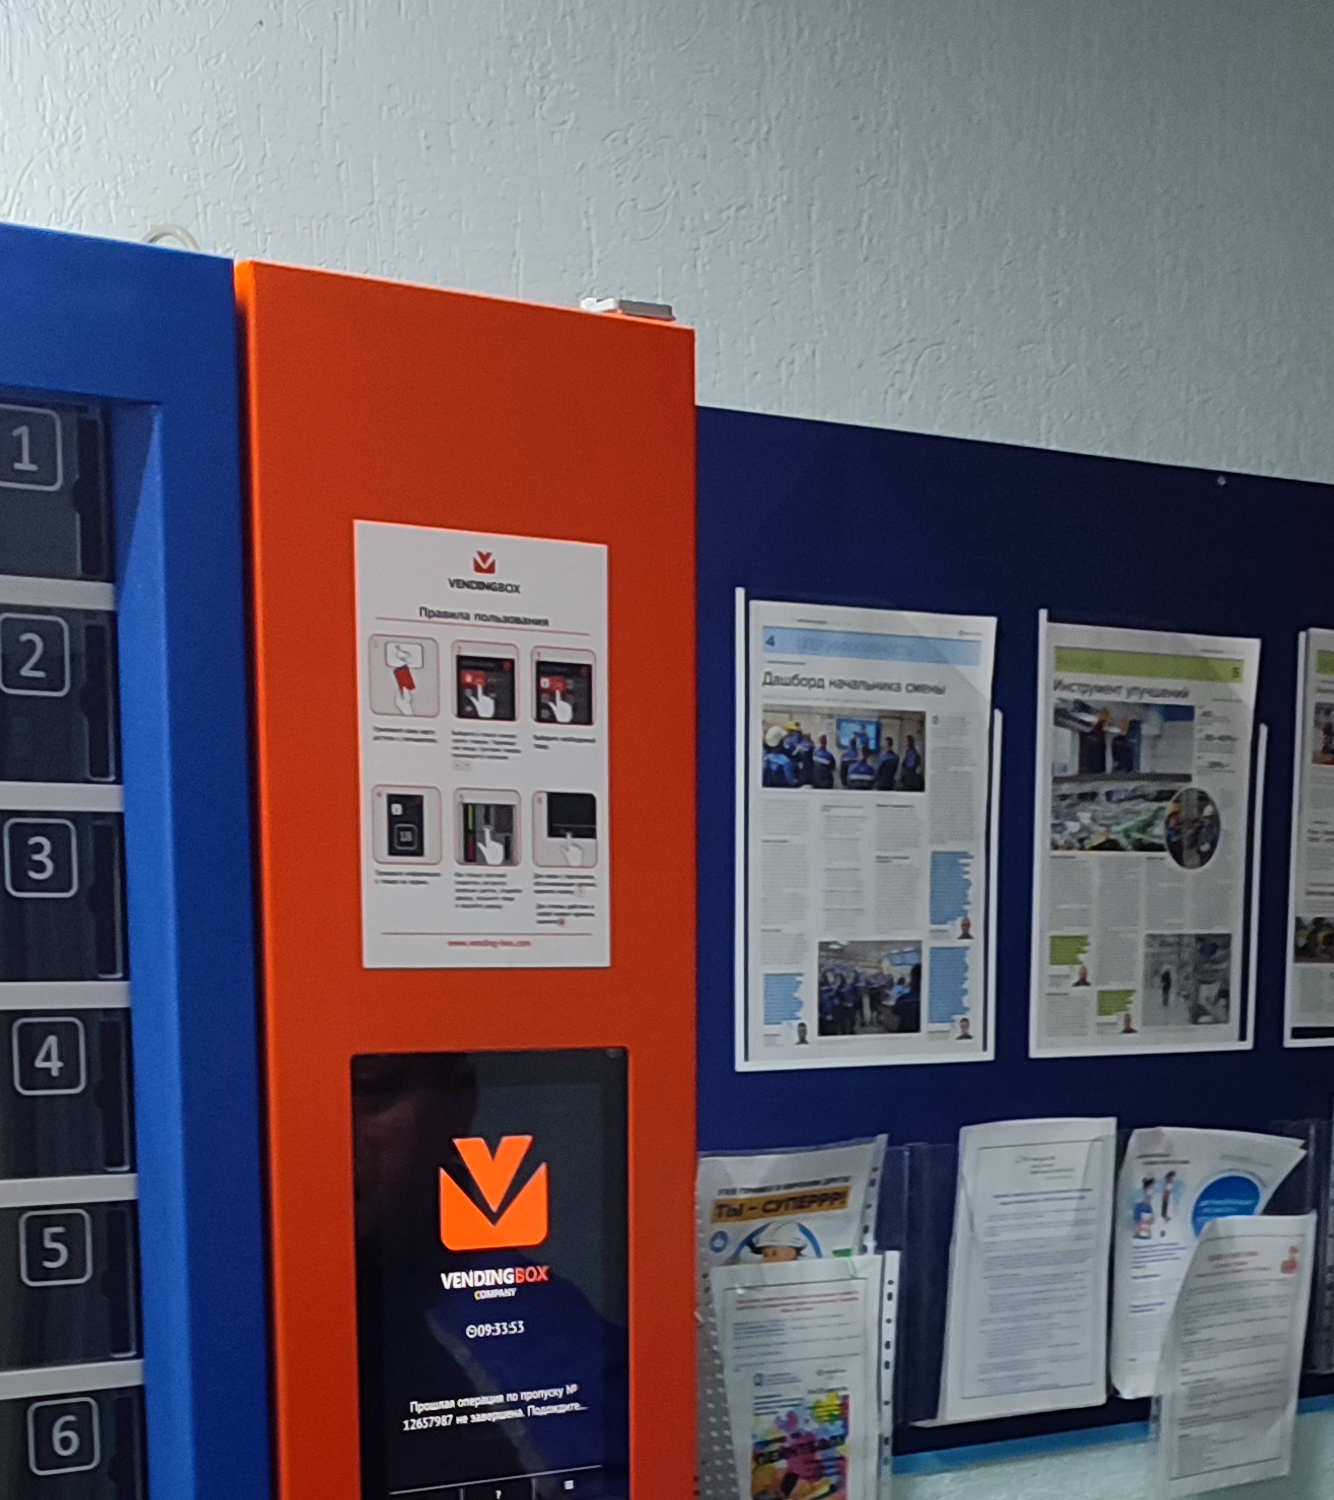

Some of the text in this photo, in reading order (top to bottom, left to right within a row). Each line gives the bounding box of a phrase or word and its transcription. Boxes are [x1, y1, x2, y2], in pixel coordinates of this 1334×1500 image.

[12, 425, 38, 471] 1
[447, 578, 520, 594] VENDINGBOX
[419, 606, 549, 626] Правила пользования
[19, 632, 46, 678] 2
[762, 671, 946, 695] Дашборд начальника смены
[27, 836, 54, 880] 3
[34, 1035, 65, 1077] 4
[41, 1226, 69, 1268] 5
[440, 1265, 549, 1290] VENDINGBOX
[474, 1287, 517, 1300] COMPANY
[409, 1383, 578, 1414] Прошлая операция по пропуску №
[51, 1414, 80, 1456] 6
[402, 1414, 454, 1431] 12657987
[455, 1415, 469, 1425] не
